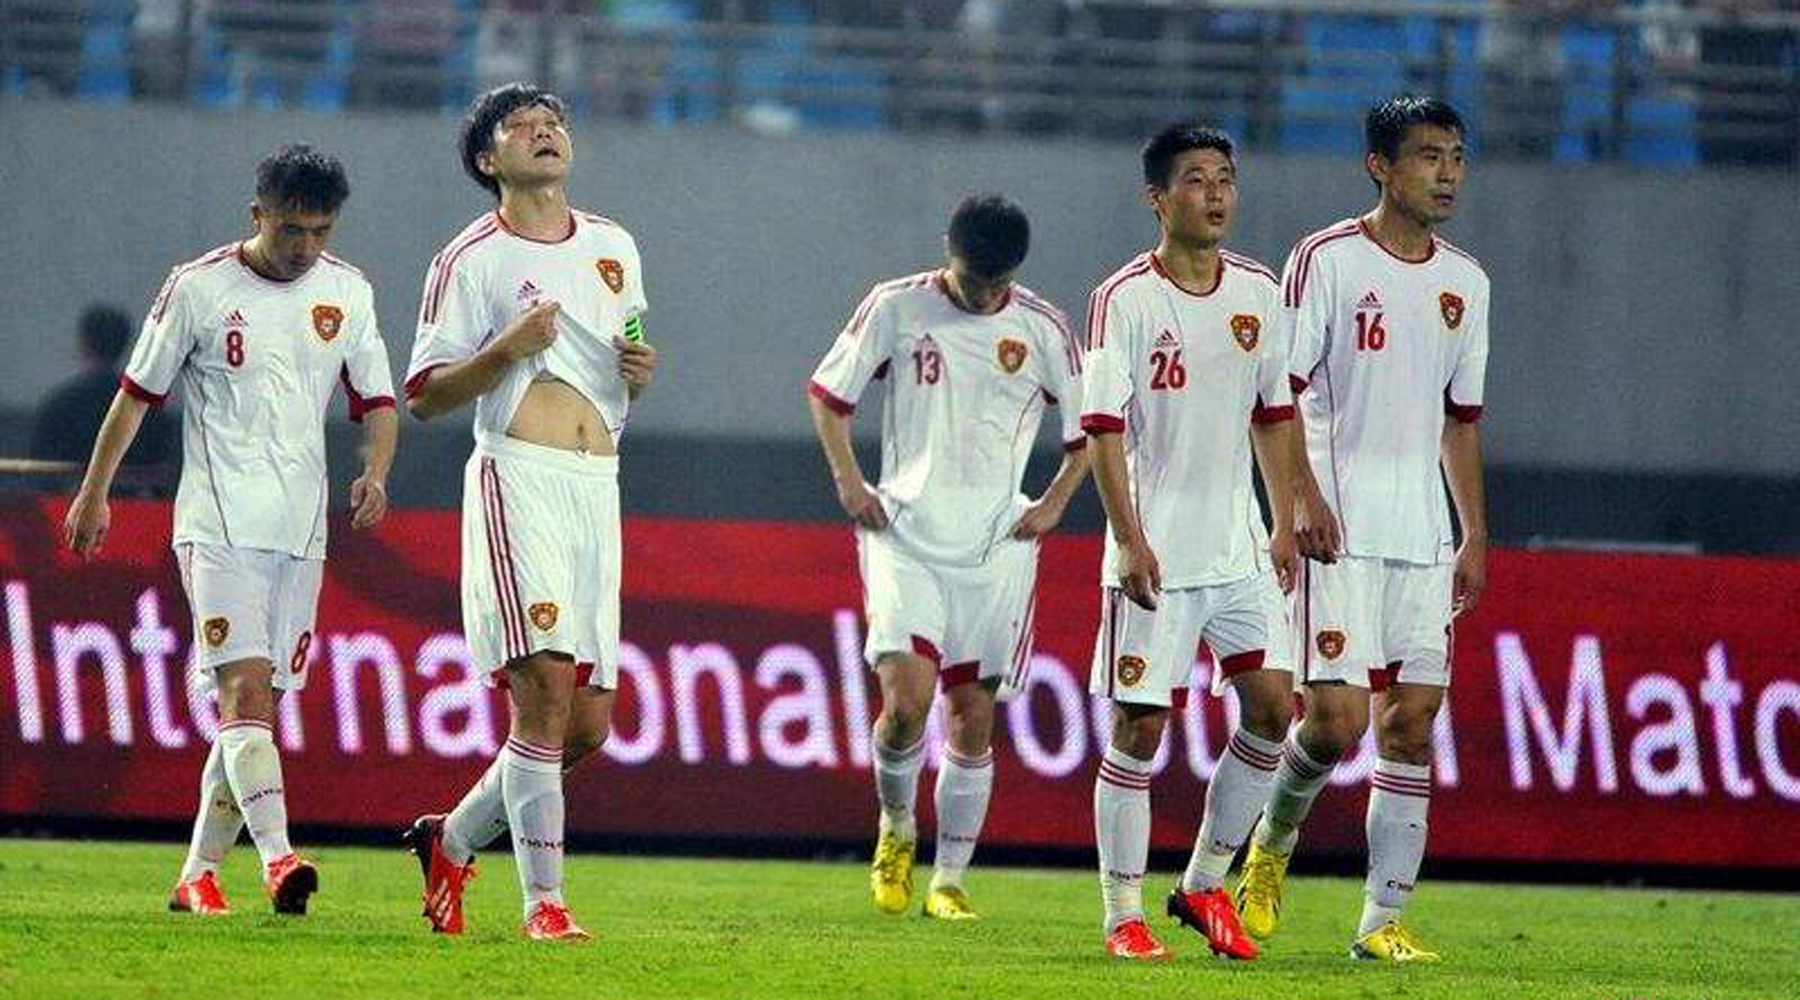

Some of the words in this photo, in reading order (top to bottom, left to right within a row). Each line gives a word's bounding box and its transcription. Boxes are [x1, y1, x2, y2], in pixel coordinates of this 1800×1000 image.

[226, 330, 245, 367] 8
[1355, 311, 1386, 351] 16
[912, 350, 941, 386] 13
[1150, 349, 1187, 390] 26
[290, 630, 312, 674] 8
[4, 581, 873, 770] Intnaonal
